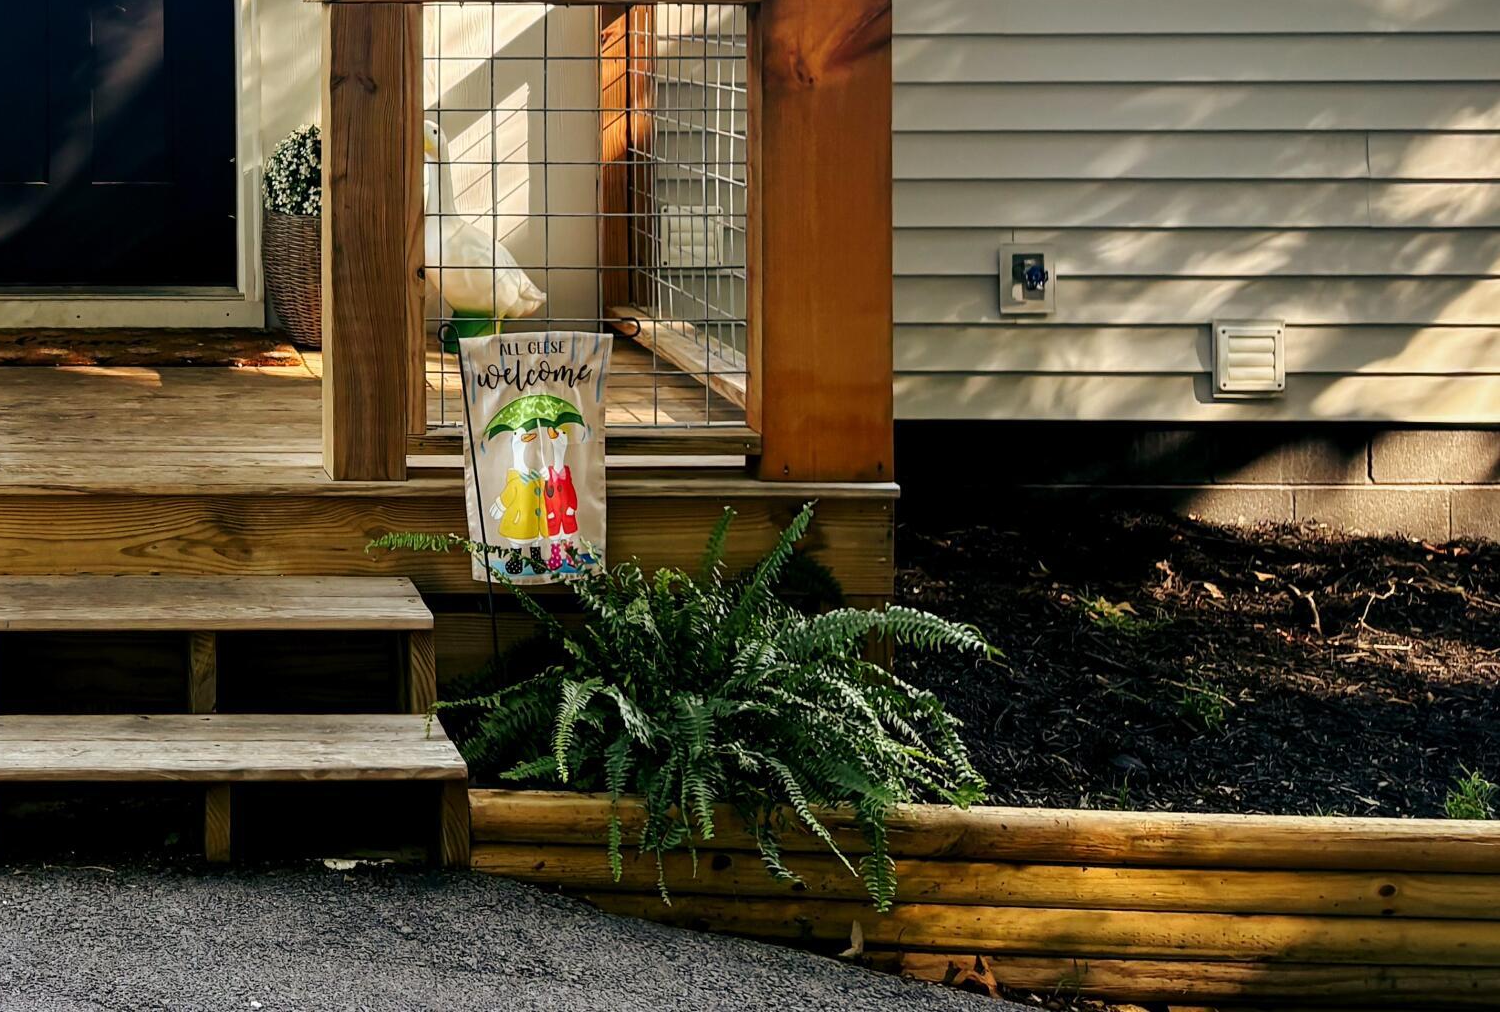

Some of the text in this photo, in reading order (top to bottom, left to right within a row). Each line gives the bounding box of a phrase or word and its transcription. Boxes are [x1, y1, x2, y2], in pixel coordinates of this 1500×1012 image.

[500, 340, 565, 356] ALL GEESE
[477, 359, 592, 391] welcome
